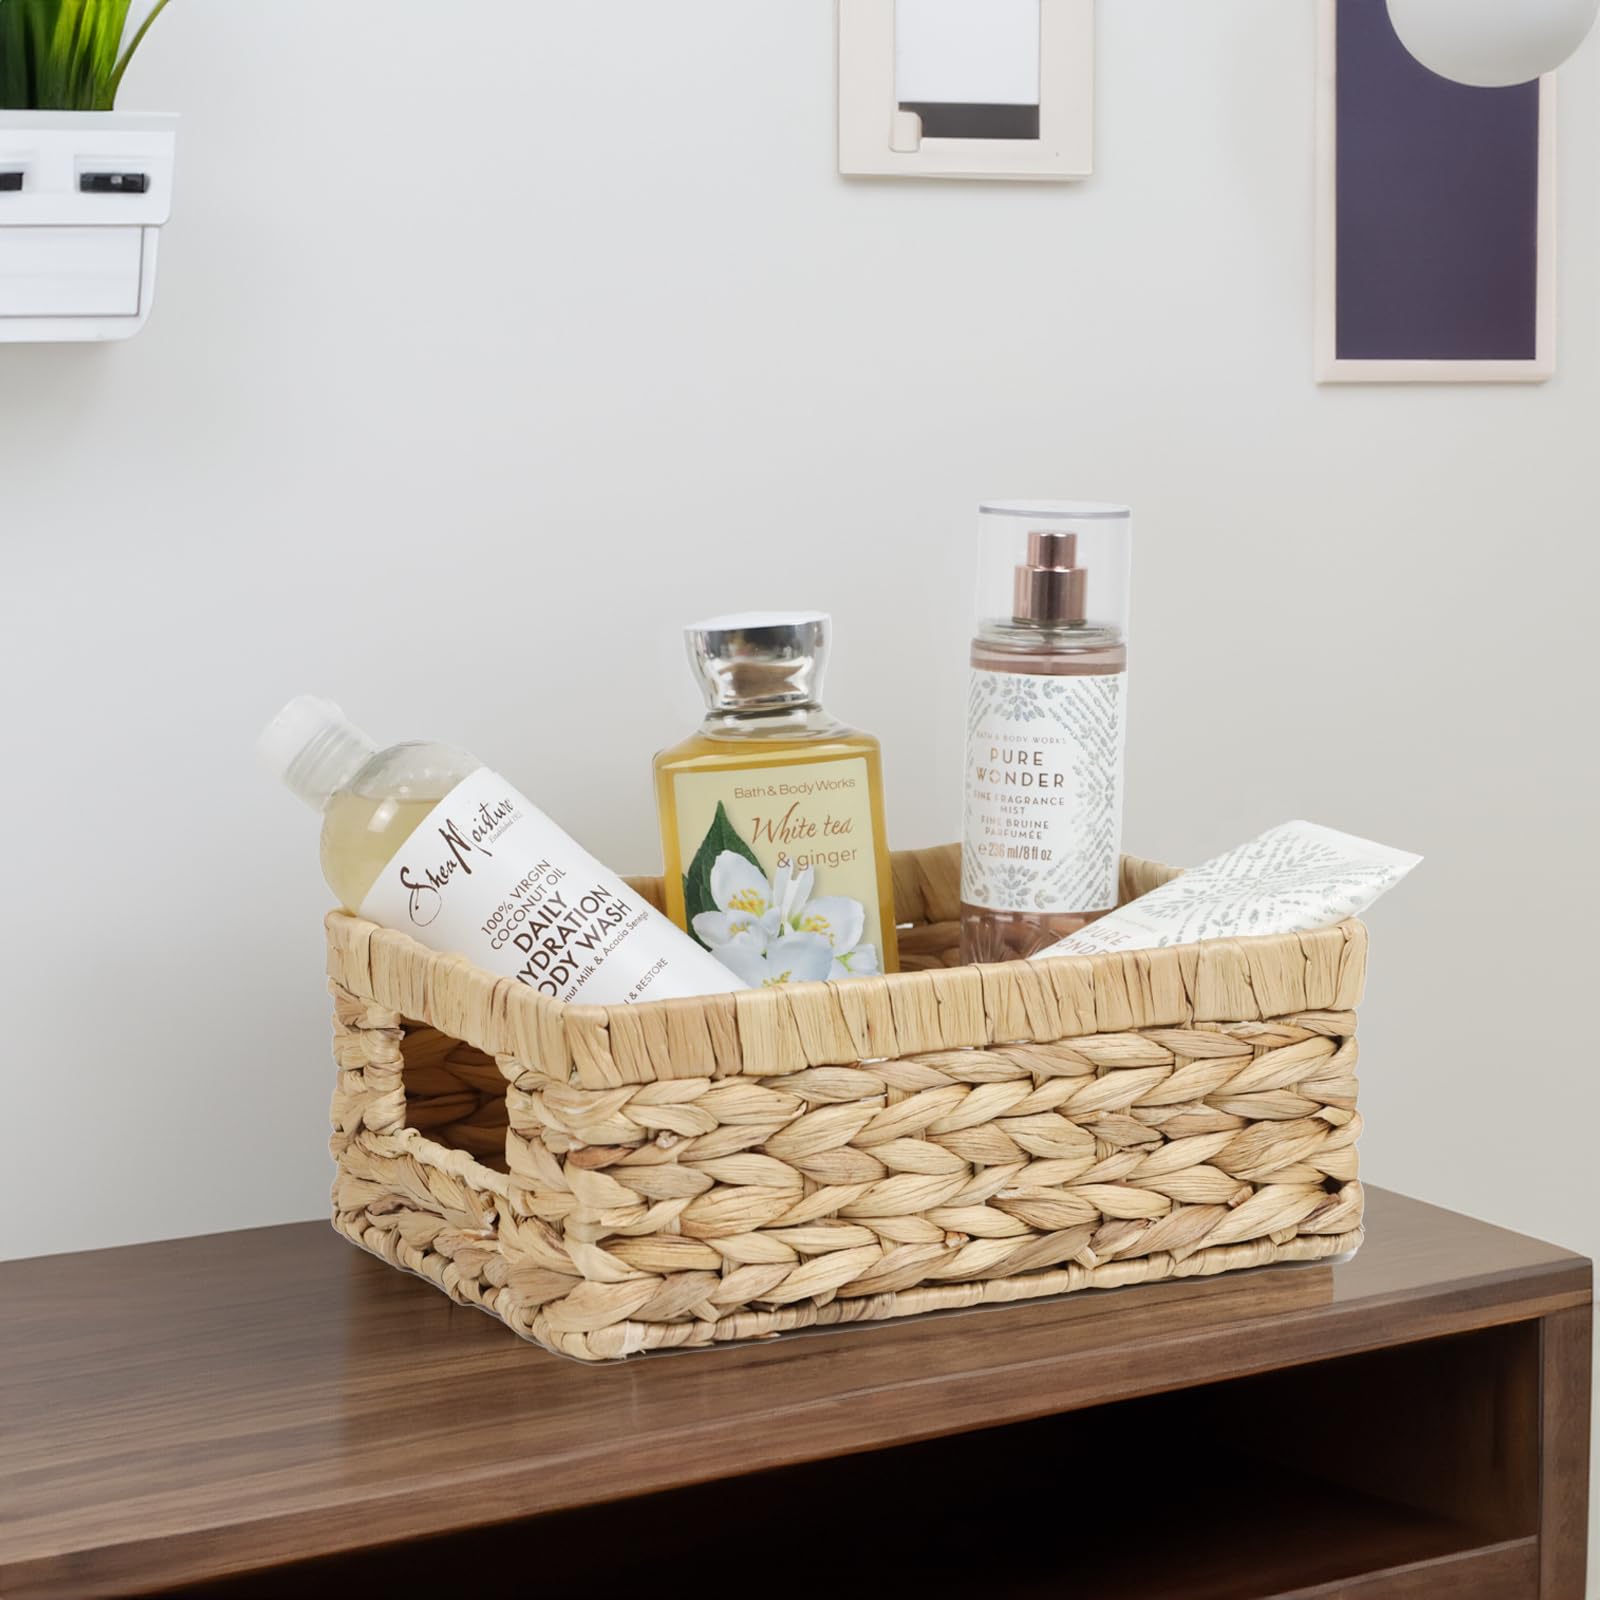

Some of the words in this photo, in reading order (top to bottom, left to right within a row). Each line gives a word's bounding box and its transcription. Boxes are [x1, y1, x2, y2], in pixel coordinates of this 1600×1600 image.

[990, 747, 1043, 766] PURE
[734, 787, 766, 799] Bath
[767, 785, 777, 796] &
[779, 783, 814, 795] Body
[816, 779, 856, 791] Works
[976, 767, 1065, 788] WONDER
[994, 792, 1065, 806] FRAGRANCE
[1000, 805, 1026, 815] MIST
[751, 801, 817, 844] White
[823, 814, 855, 837] tea
[985, 826, 1042, 840] PARFUMÉE
[1006, 818, 1049, 830] BRUINE
[777, 851, 791, 869] &
[797, 848, 858, 871] ginger
[1041, 849, 1053, 861] oz
[481, 901, 514, 935] 100%
[509, 859, 551, 899] VIRGIN
[491, 884, 548, 949] COCONUT
[546, 868, 567, 885] OIL
[513, 890, 568, 954] DAILY
[516, 884, 613, 987] YDRATION
[538, 950, 580, 997] ODY
[575, 898, 633, 951] WASH
[576, 965, 597, 987] Milk
[593, 955, 605, 965] &
[603, 929, 629, 957] Acacia
[628, 992, 638, 1000] &
[635, 957, 669, 992] RESTORE
